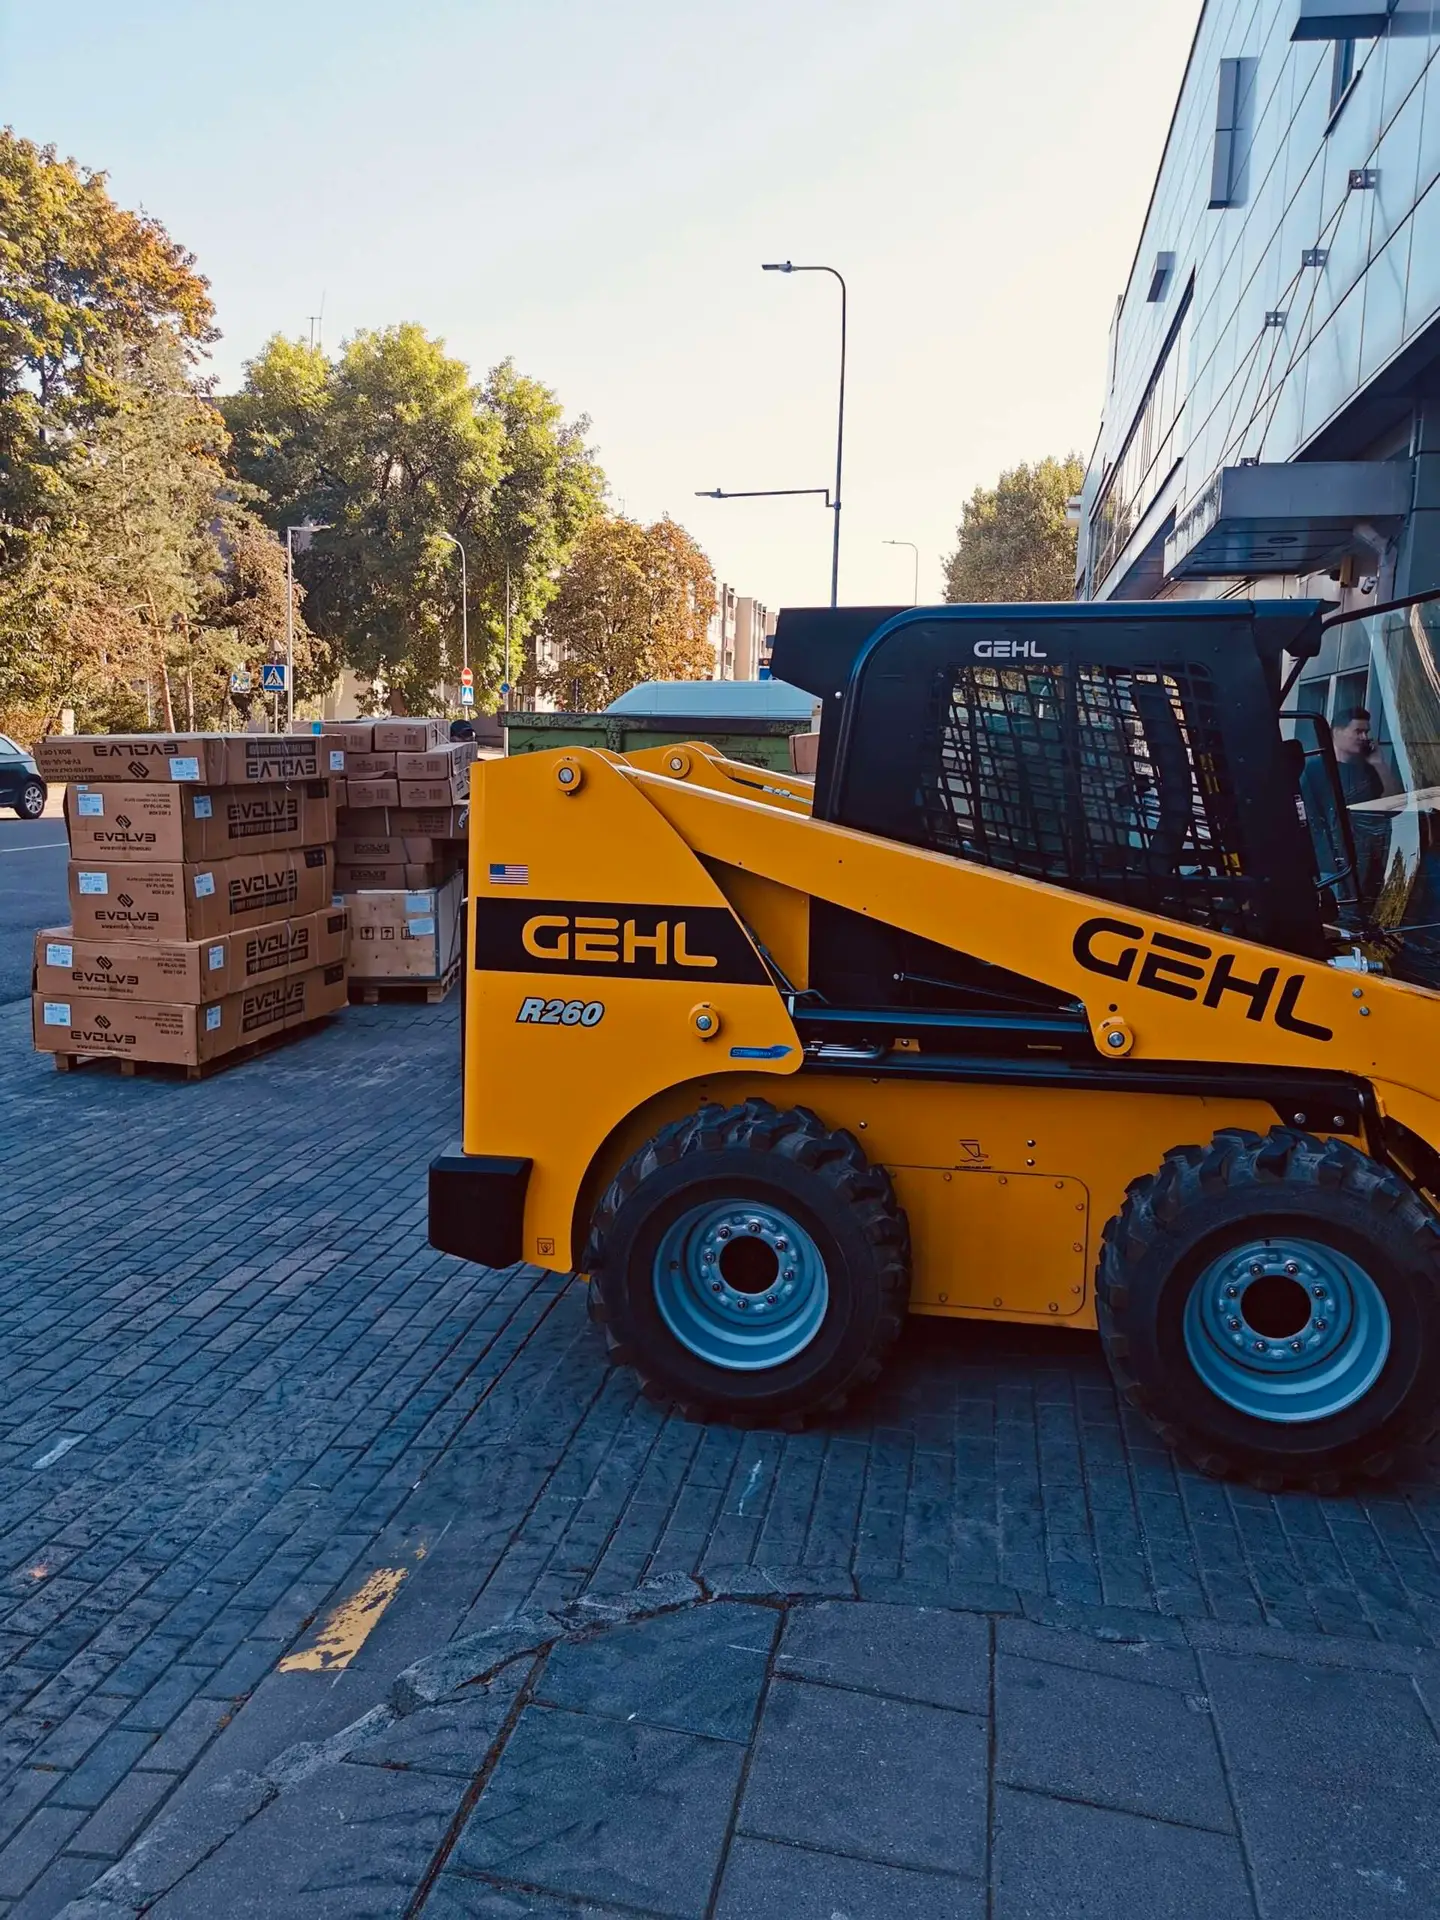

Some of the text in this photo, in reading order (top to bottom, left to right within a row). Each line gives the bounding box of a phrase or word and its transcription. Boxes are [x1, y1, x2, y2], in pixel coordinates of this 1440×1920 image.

[973, 640, 1048, 658] GEHL
[93, 743, 179, 757] EVOLVE
[246, 759, 316, 778] EVOLVE
[227, 799, 298, 820] EVOLVE
[94, 832, 156, 842] EVOLVE
[228, 869, 298, 897] EVOLVE
[95, 911, 159, 921] EVOLVE
[246, 928, 309, 958] EVOLVE
[522, 915, 718, 967] GEHL
[72, 971, 139, 985] EVOLVE
[1072, 917, 1333, 1042] GEHL
[243, 981, 305, 1015] EVOLVE
[515, 997, 605, 1027] R260
[71, 1030, 136, 1044] EVOLVE
